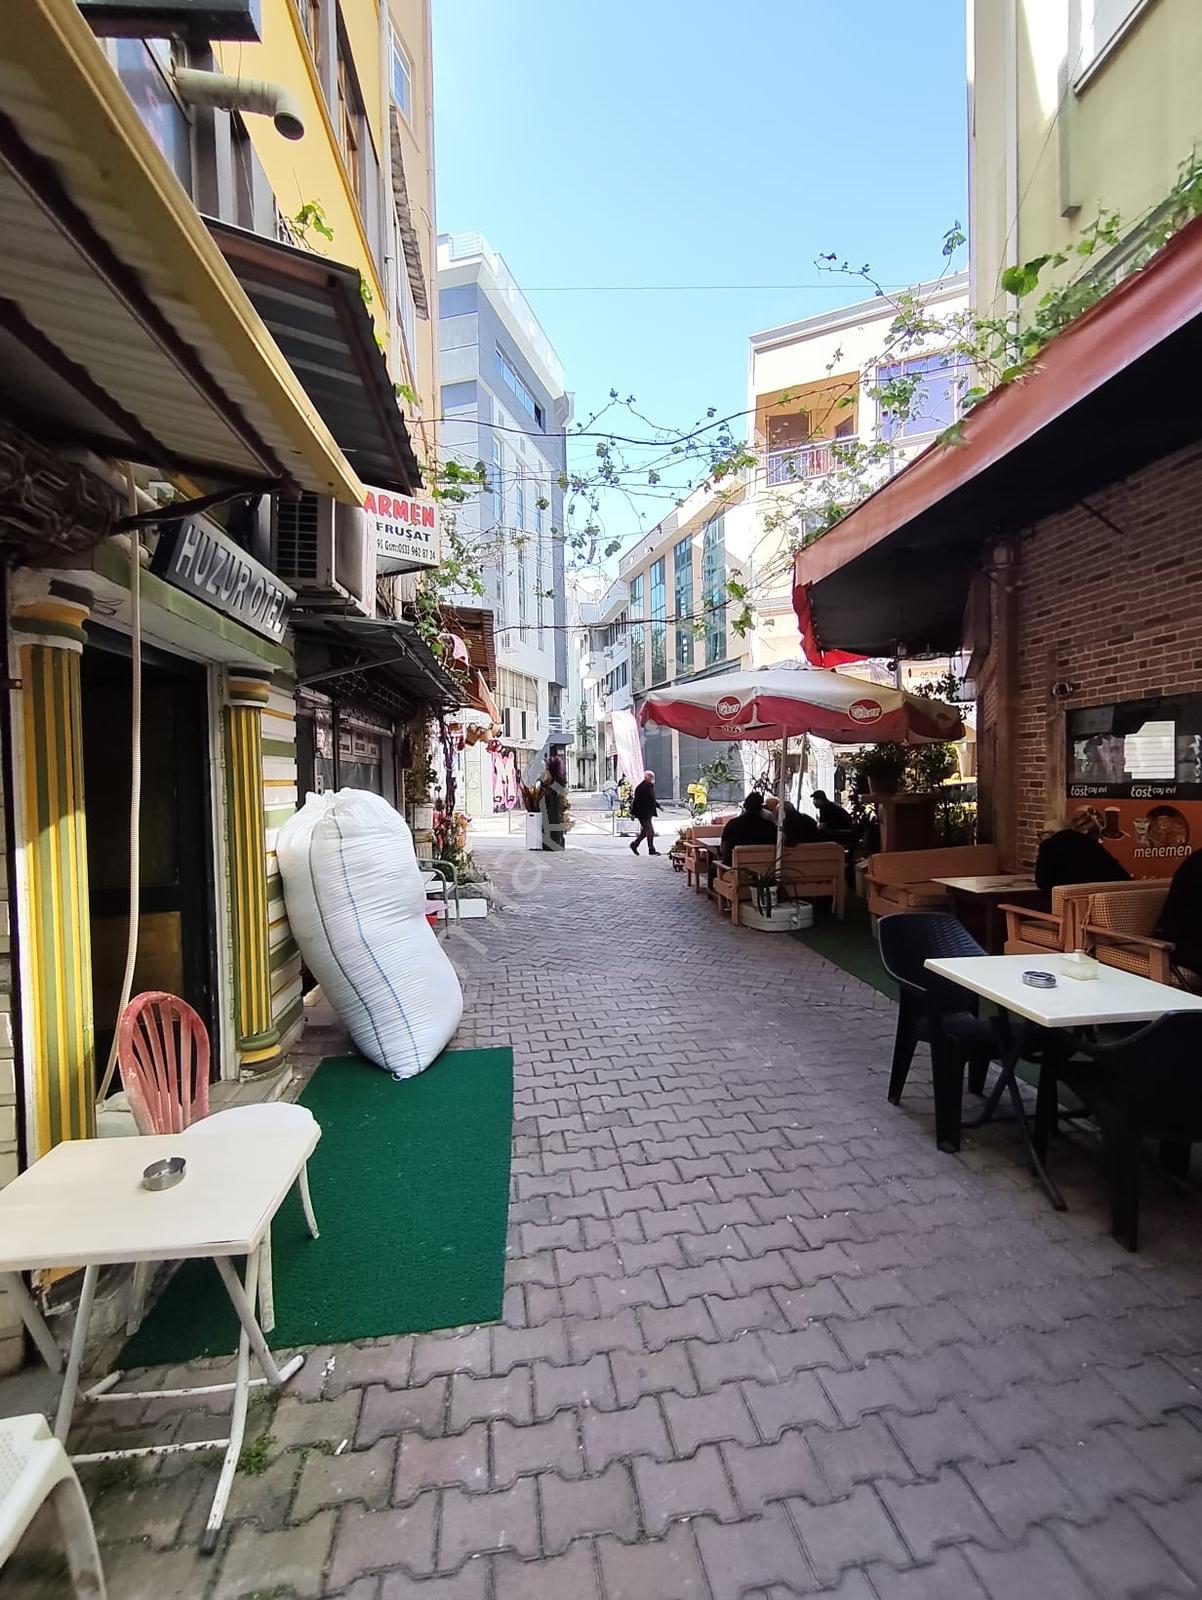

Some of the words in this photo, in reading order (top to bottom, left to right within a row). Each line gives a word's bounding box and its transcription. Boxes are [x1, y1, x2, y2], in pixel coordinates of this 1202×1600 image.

[175, 523, 252, 611] HUZUR
[250, 576, 288, 634] OTEL
[1130, 784, 1152, 798] tost
[1133, 844, 1192, 859] menemen
